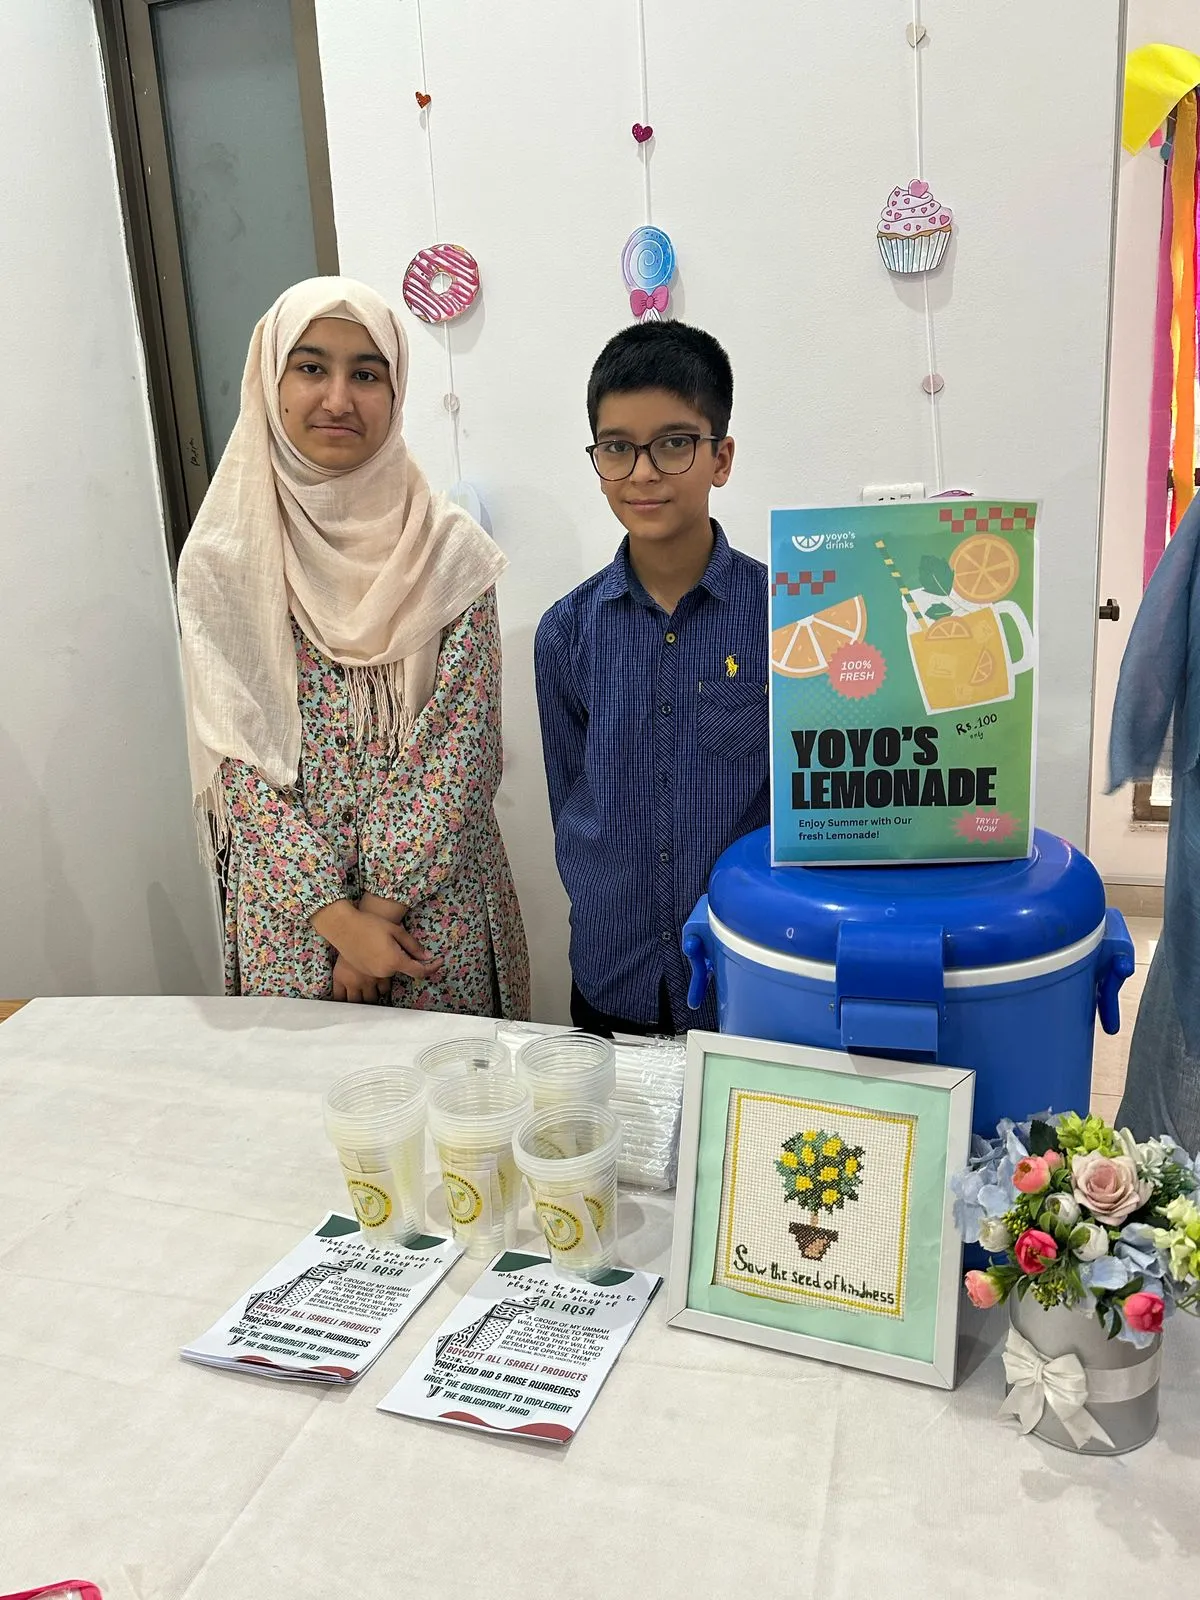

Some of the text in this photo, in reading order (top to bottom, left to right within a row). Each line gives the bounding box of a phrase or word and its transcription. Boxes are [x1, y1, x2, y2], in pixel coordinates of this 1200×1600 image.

[825, 531, 856, 543] yoyo's
[825, 541, 854, 549] drinks
[841, 660, 872, 671] 100%
[839, 671, 875, 682] FRESH
[791, 726, 939, 769] YOYO'S
[791, 767, 998, 810] LEMONADE
[798, 816, 913, 829] Enjoy Summer with Our
[975, 817, 991, 825] TRY
[798, 830, 880, 841] fresh Lemonade!
[352, 1260, 404, 1277] AL AQSA
[770, 1261, 788, 1280] the
[791, 1270, 821, 1289] seed
[823, 1274, 842, 1291] of
[840, 1281, 895, 1305] kindness
[254, 1302, 291, 1315] BOYCOTT
[289, 1309, 307, 1318] ALL
[305, 1313, 339, 1325] ISRAELI
[337, 1320, 382, 1334] PRODUCTS
[539, 1298, 596, 1318] AL AQSA
[279, 1322, 297, 1330] AID
[300, 1326, 326, 1337] RAISE
[322, 1331, 372, 1348] AWARENESS
[515, 1318, 535, 1326] WILL
[533, 1322, 571, 1334] CONTINUE
[581, 1331, 611, 1341] PREVAIL
[532, 1316, 559, 1325] GROUP
[580, 1325, 610, 1334] UMMAH
[534, 1328, 550, 1336] THE
[549, 1331, 571, 1340] BASIS
[227, 1326, 360, 1360] URGE THE GOVERNMENT TO IMPLEMENT
[500, 1339, 528, 1349] BETRAY
[539, 1347, 570, 1358] OPPOSE
[507, 1328, 604, 1352] TRUTH, AND THEY WILL NOT
[514, 1336, 546, 1347] HARMED
[555, 1344, 582, 1354] THOSE
[579, 1349, 601, 1357] WHO
[255, 1343, 300, 1356] OBLIGATORY
[295, 1351, 321, 1361] JIHAD
[444, 1345, 589, 1382] BOYCOTT ALL ISRAELI PRODUCTS
[422, 1373, 573, 1414] URGE THE GOVERNMENT TO IMPLEMENT
[477, 1369, 496, 1379] AID
[493, 1372, 503, 1380] &
[501, 1373, 529, 1386] RAISE
[527, 1379, 581, 1398] AWARENESS
[440, 1390, 531, 1416] THE OBLIGATORY JIHAD
